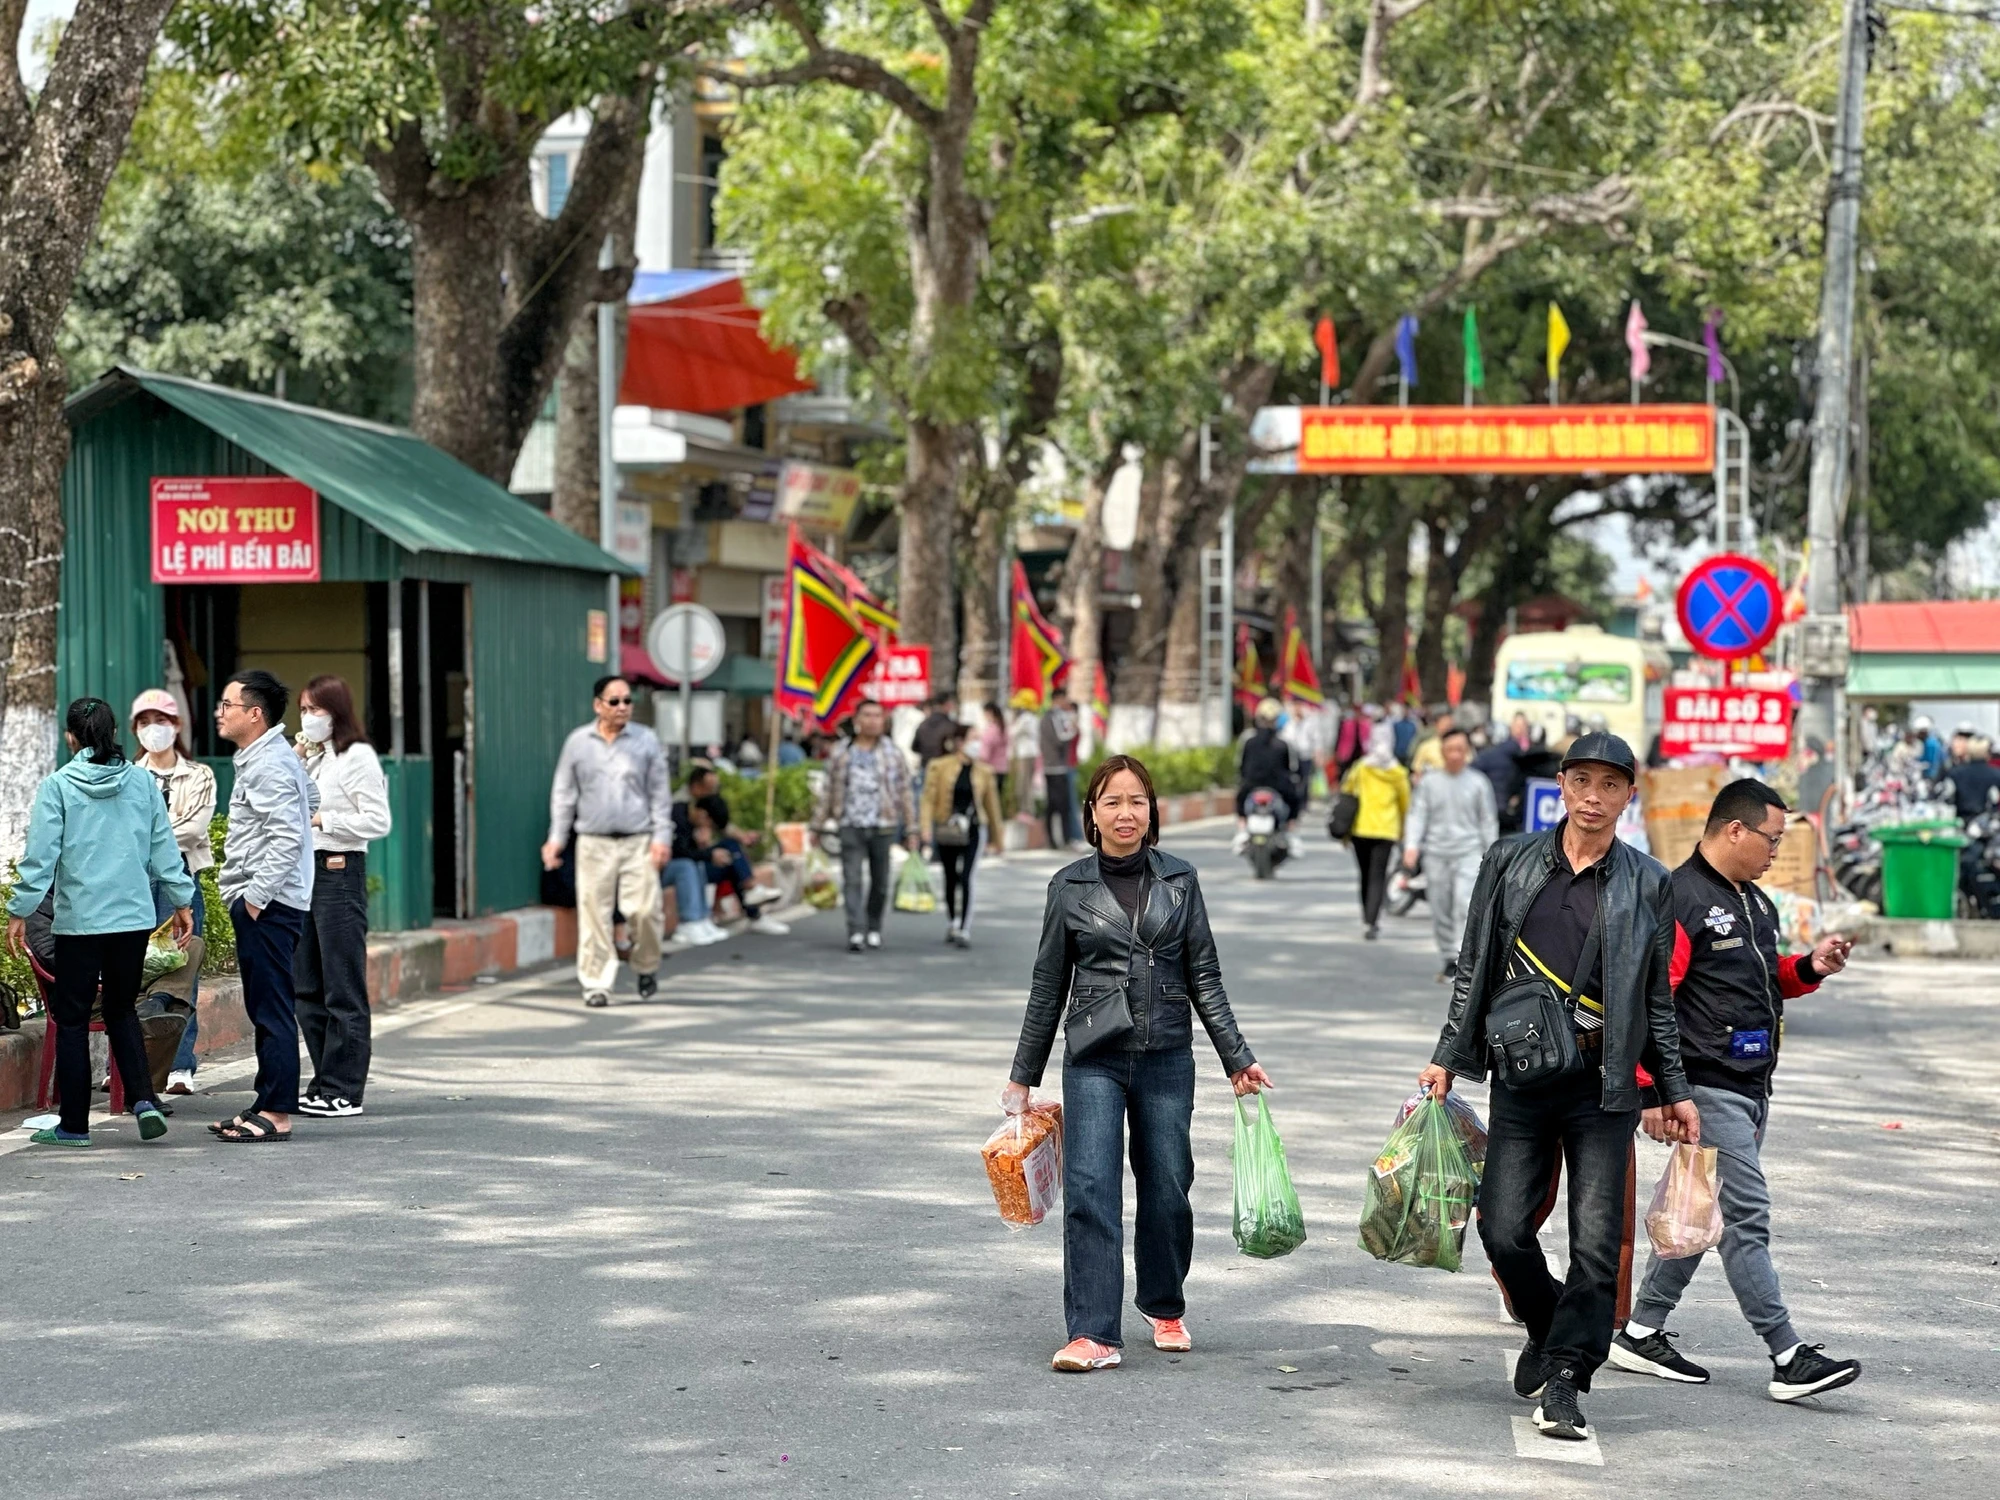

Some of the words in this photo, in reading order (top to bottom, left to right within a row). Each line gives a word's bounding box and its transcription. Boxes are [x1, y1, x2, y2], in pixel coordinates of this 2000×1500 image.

[177, 506, 230, 533] NƠI
[235, 507, 295, 532] THU
[162, 540, 187, 575] LỆ
[191, 540, 226, 569] PHÍ
[230, 536, 271, 569] BẾN
[276, 539, 312, 569] BÃI
[1723, 691, 1760, 722] SỐ
[1762, 698, 1781, 723] 3
[1506, 1019, 1521, 1028] Jeep
